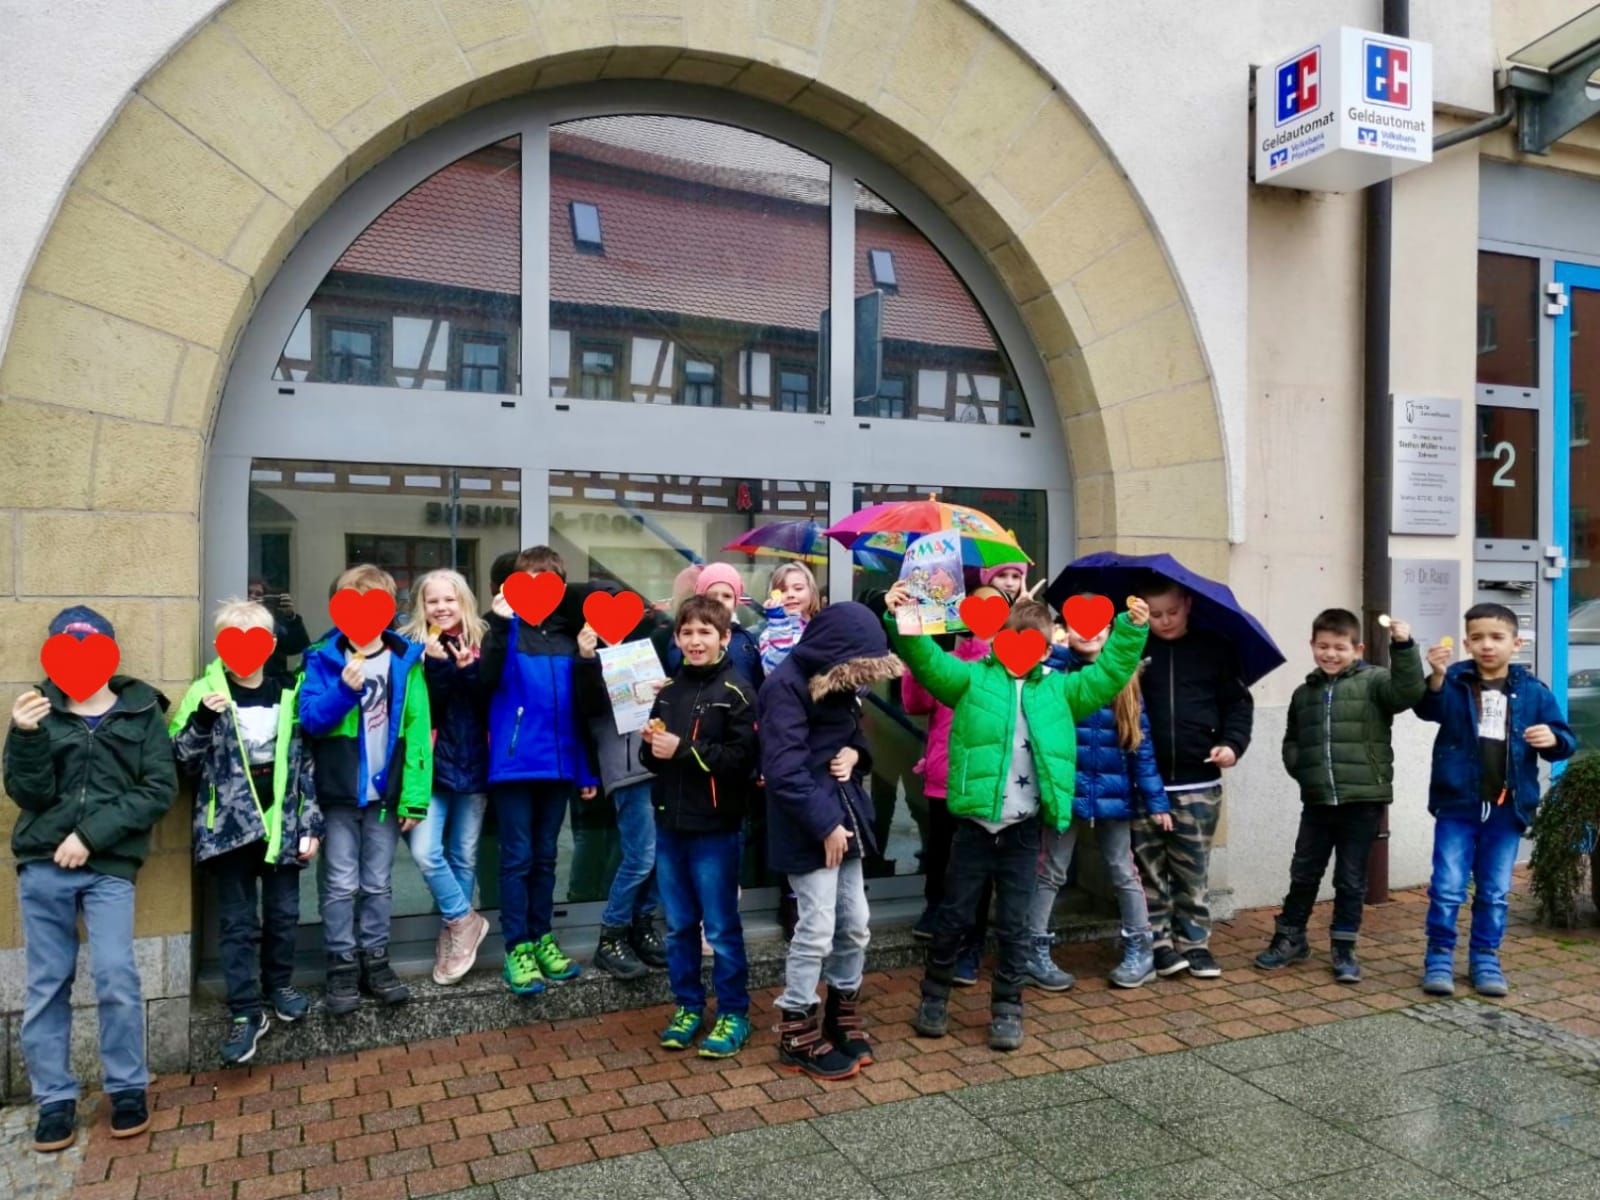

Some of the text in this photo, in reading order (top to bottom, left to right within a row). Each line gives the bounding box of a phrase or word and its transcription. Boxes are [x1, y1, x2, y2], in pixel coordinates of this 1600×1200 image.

[1262, 111, 1335, 152] Geldautomat
[1348, 107, 1426, 132] Geldautomat
[1492, 441, 1516, 487] 2
